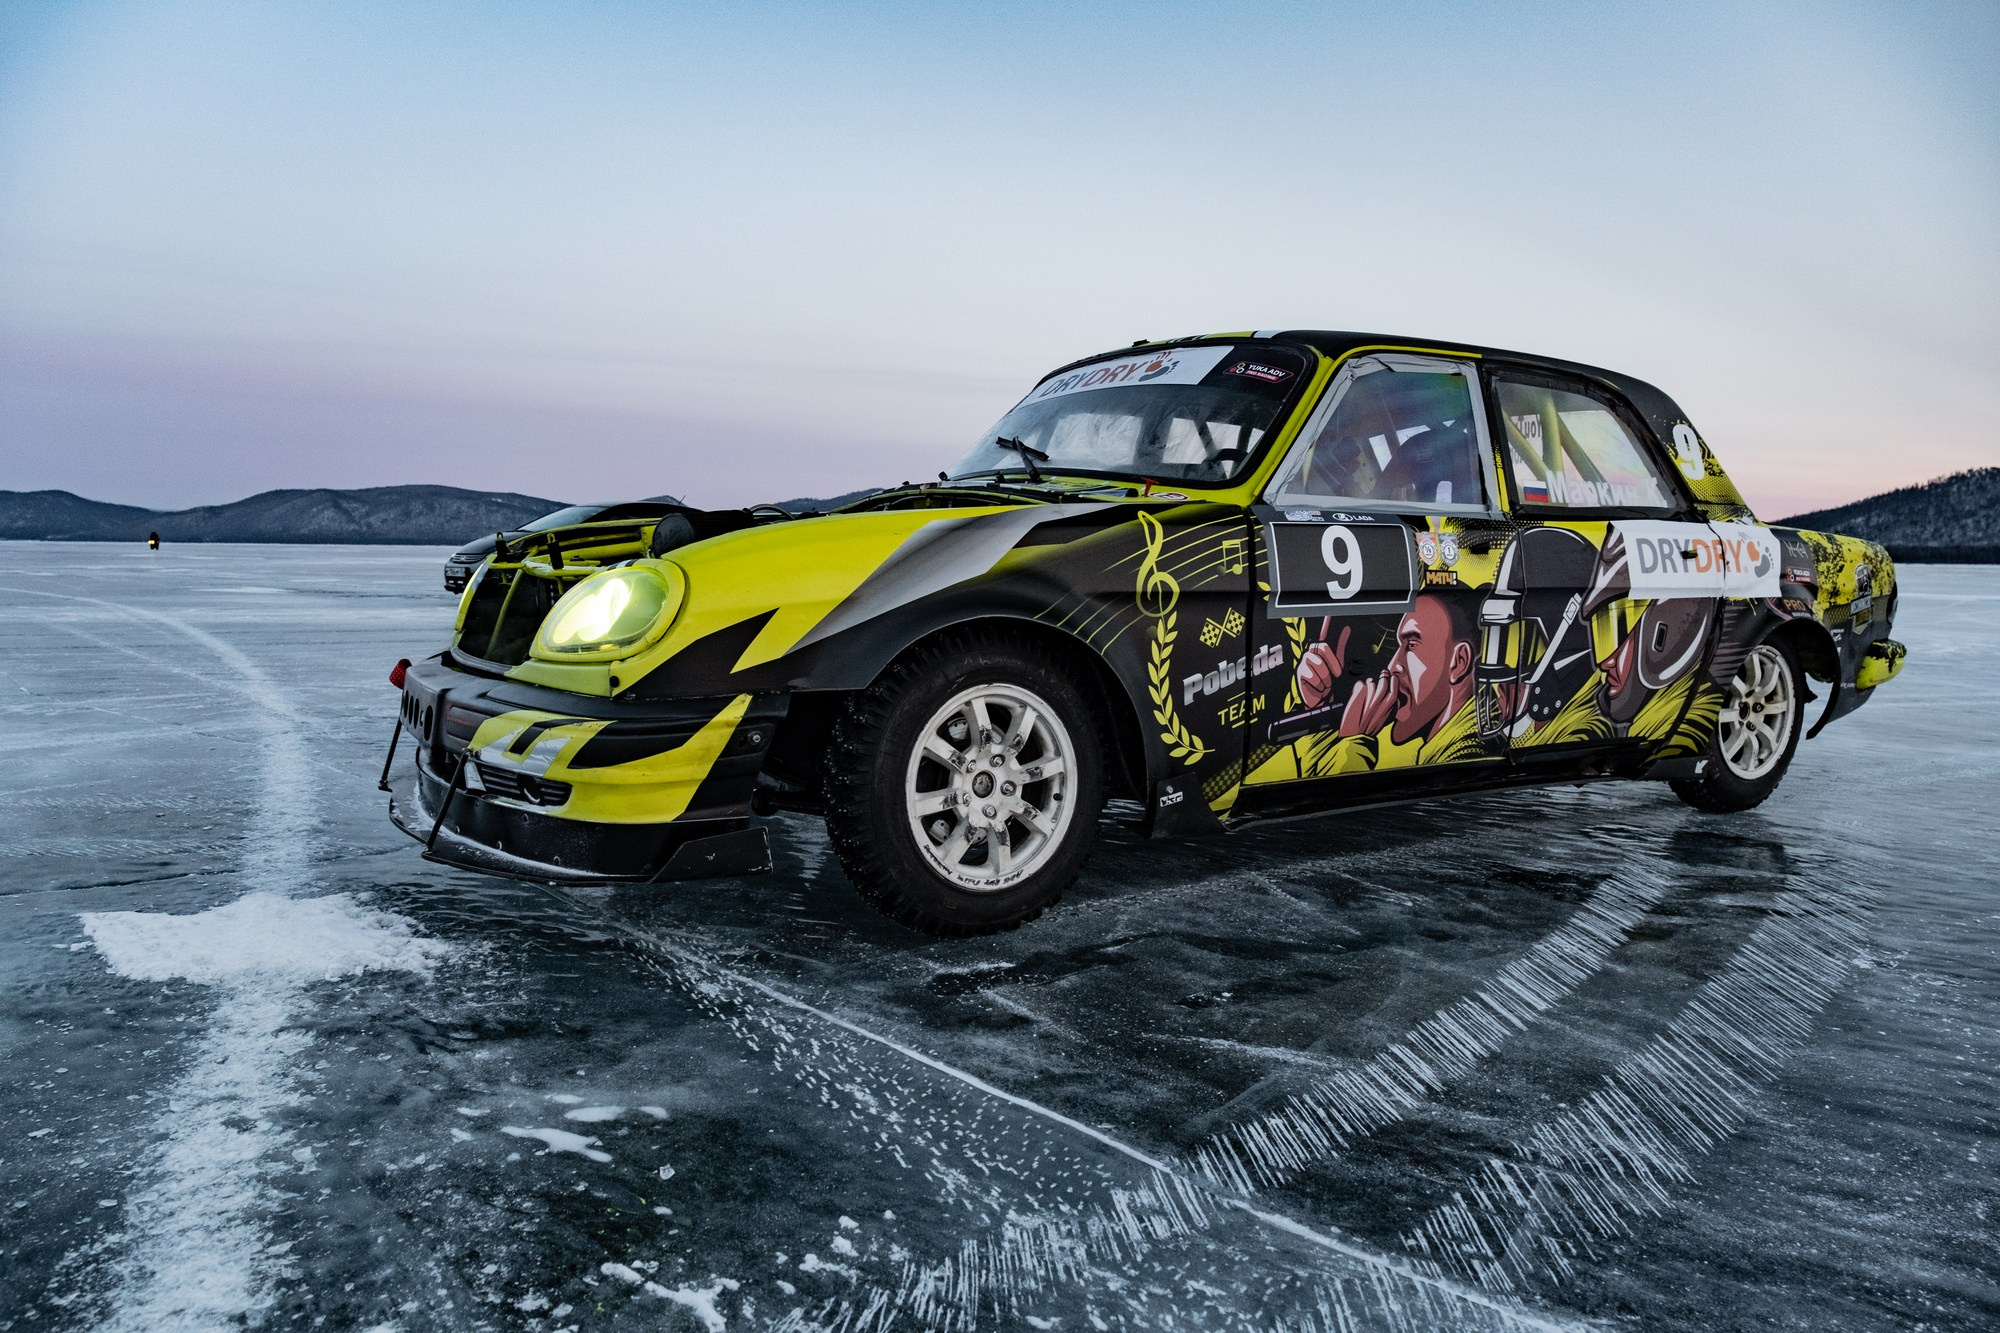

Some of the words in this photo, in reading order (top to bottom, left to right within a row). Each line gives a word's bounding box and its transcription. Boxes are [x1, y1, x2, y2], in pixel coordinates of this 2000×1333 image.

[1249, 364, 1268, 373] YUKA
[1268, 368, 1286, 377] ADV
[1672, 423, 1705, 481] 9
[1352, 514, 1375, 522] LADA
[1321, 525, 1363, 600] 9
[1183, 644, 1284, 706] Pobeda
